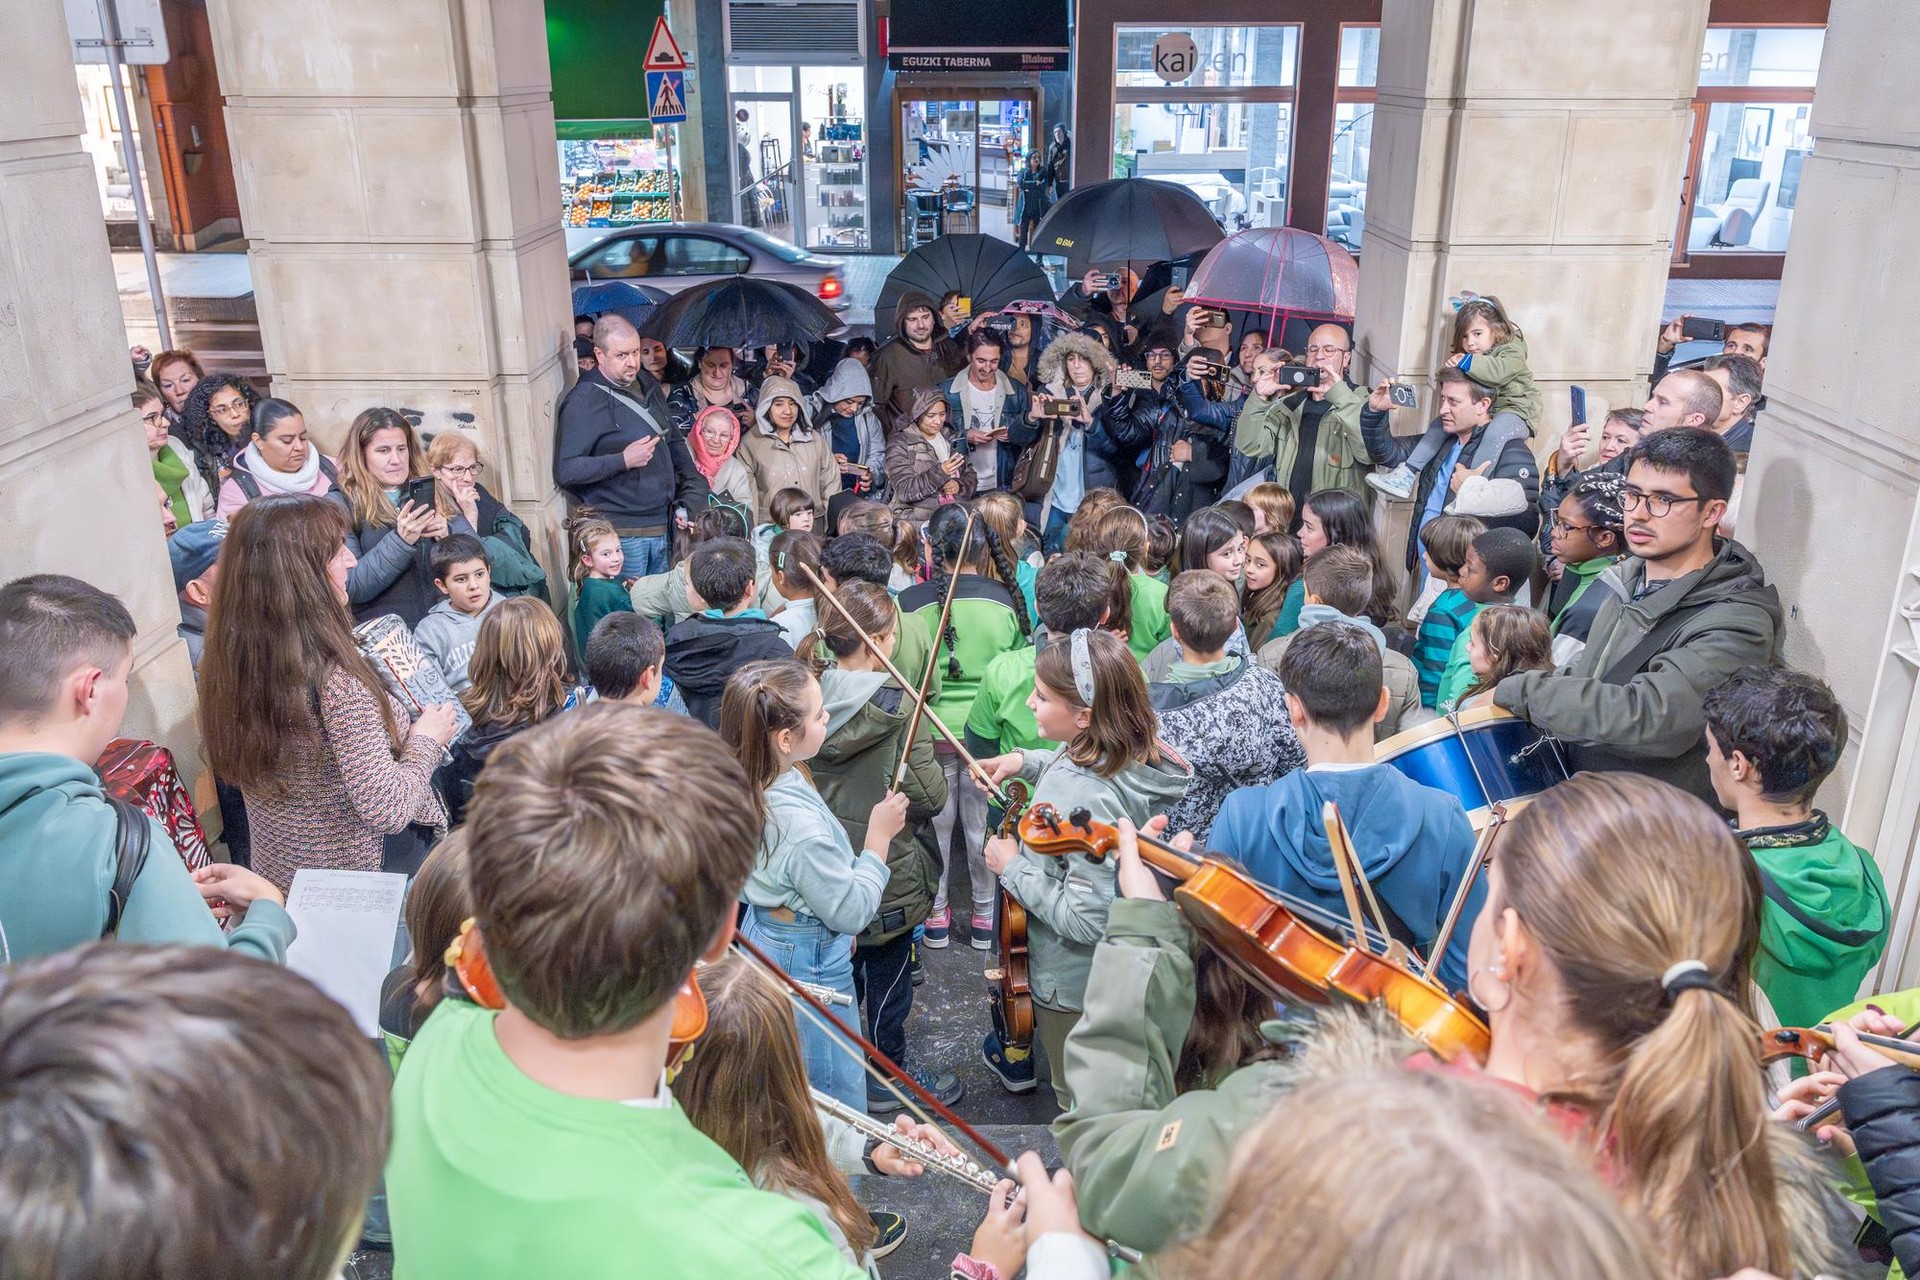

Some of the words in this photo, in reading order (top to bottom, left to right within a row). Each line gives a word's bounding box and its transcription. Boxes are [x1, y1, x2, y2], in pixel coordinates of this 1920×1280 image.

[902, 56, 941, 66] EGUZKI
[943, 57, 992, 67] TABERNA
[1155, 44, 1247, 72] kaizen
